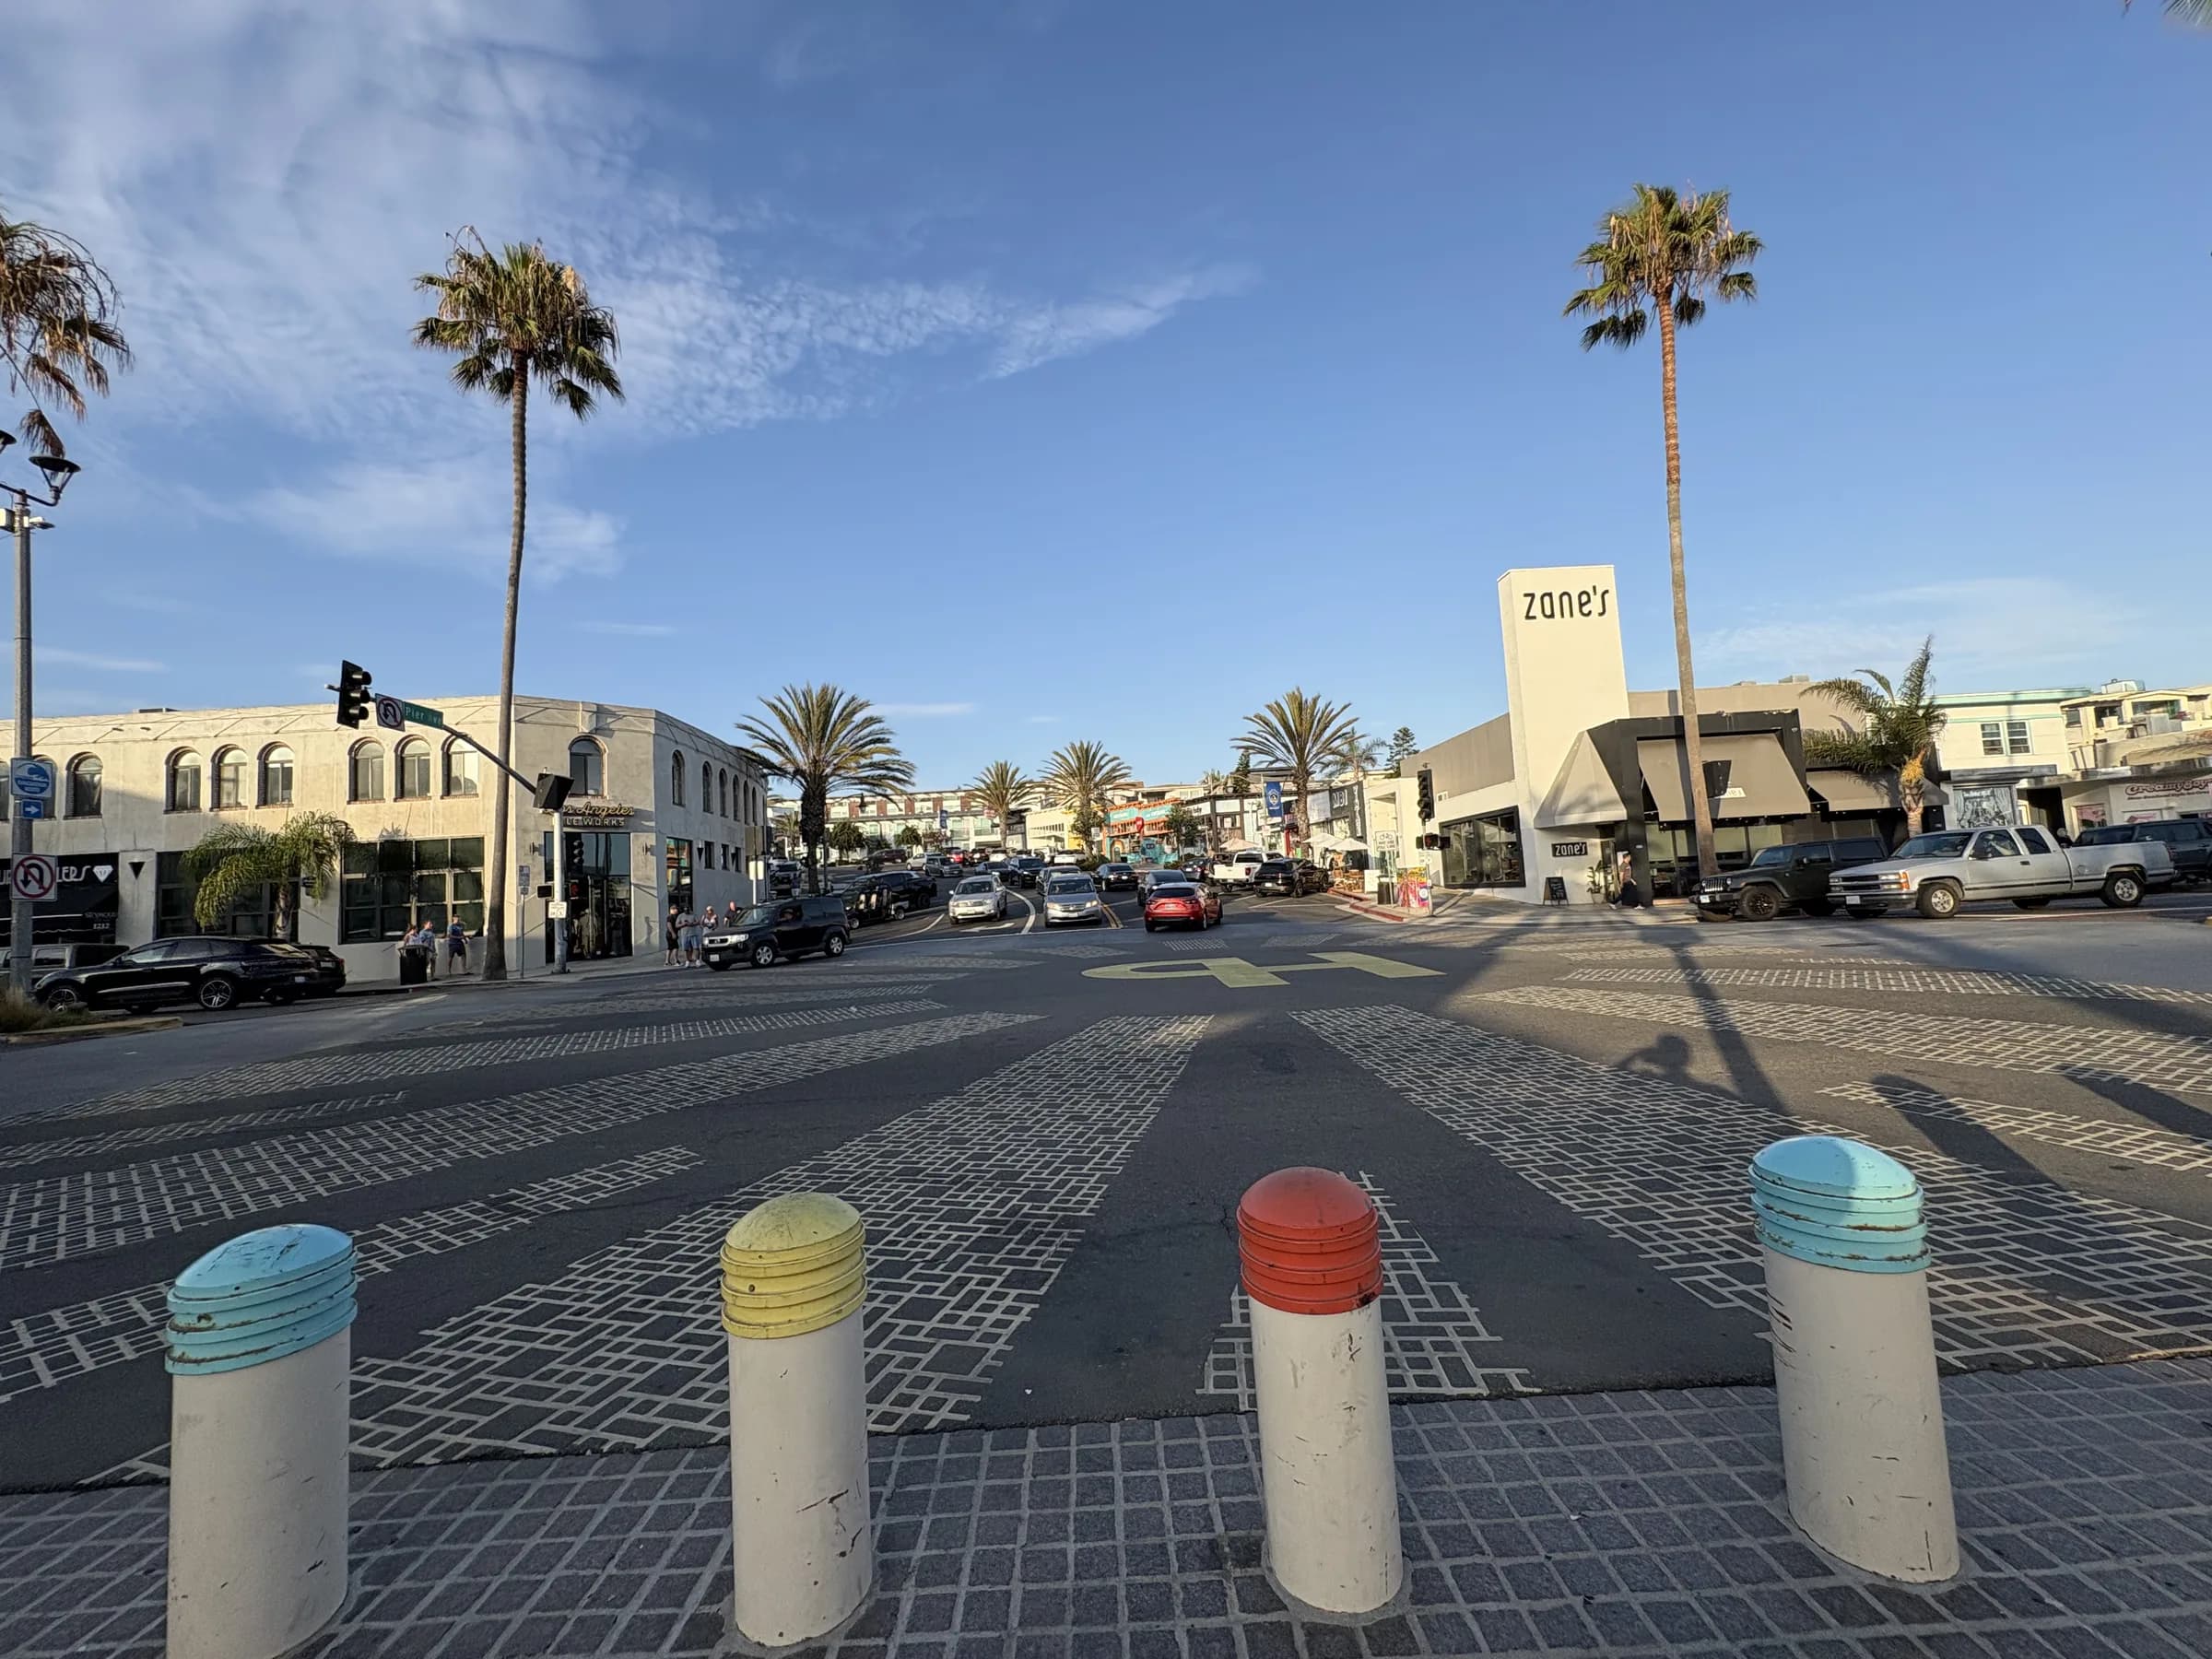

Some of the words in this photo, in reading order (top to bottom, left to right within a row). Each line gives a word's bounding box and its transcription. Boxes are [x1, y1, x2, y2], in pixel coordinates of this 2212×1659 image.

[1523, 584, 1609, 620] zane's
[406, 706, 425, 721] Pier
[576, 801, 635, 818] Angeles
[582, 818, 625, 827] WORKS
[1555, 842, 1586, 856] zane's
